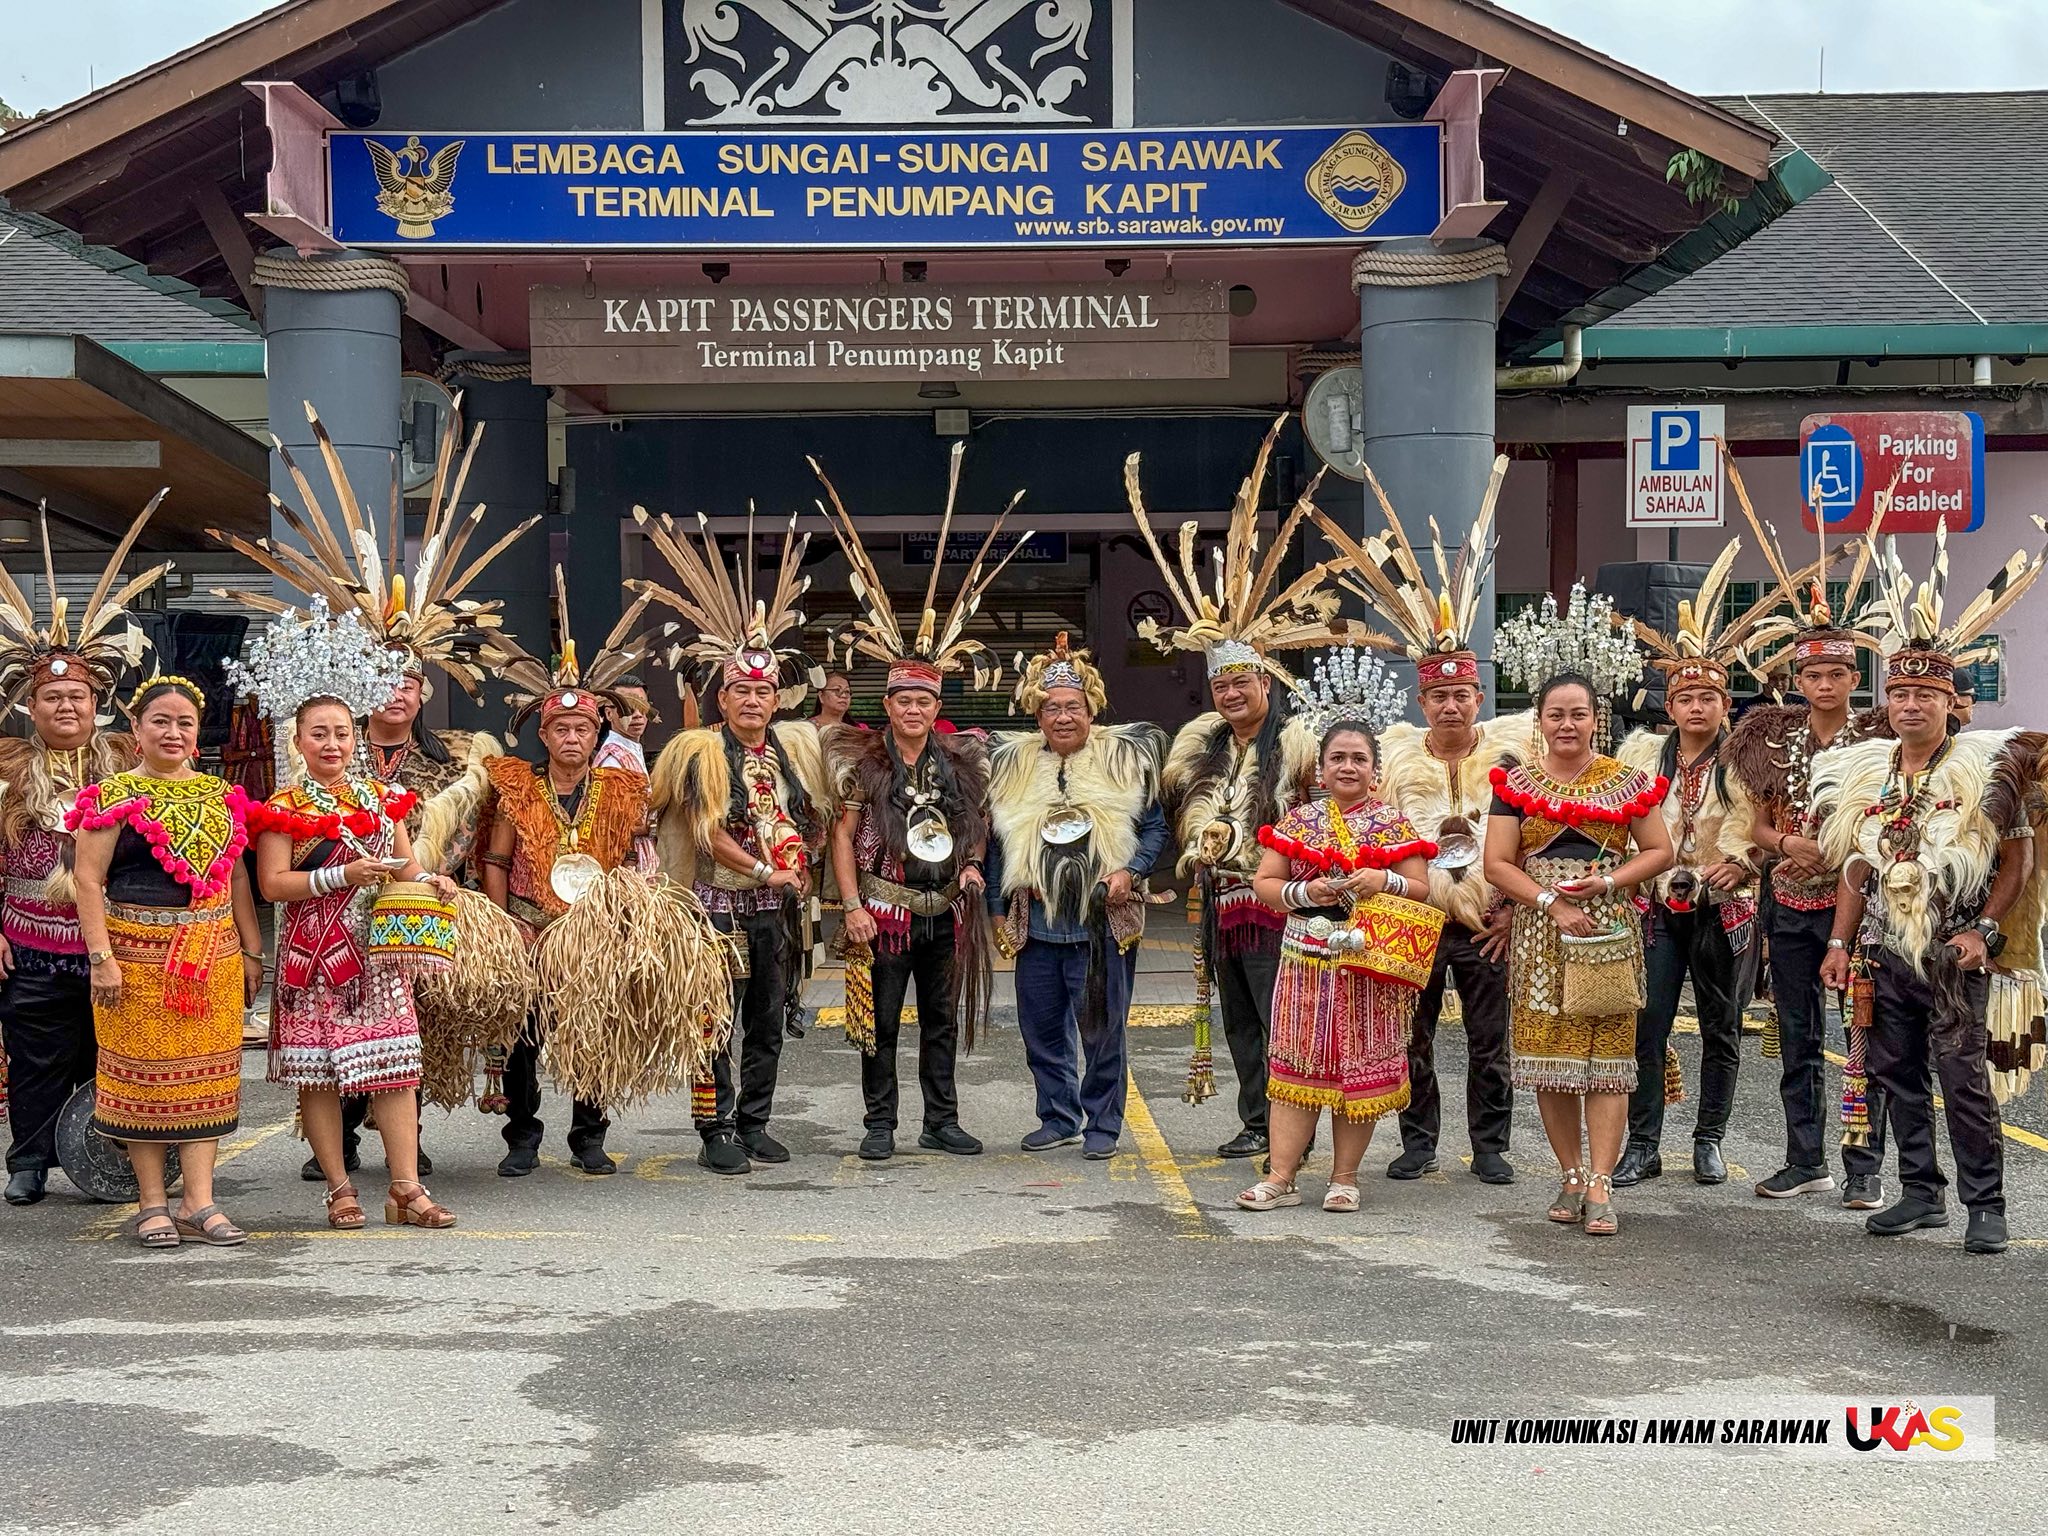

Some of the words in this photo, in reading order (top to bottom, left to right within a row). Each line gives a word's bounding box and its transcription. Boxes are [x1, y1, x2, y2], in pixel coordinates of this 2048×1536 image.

[487, 144, 683, 174] LEMBAGA
[719, 142, 1047, 173] SUNGAI-SUNGAI
[1082, 139, 1282, 171] SARAWAK
[1323, 154, 1342, 200] LEMBAGA
[569, 187, 773, 217] TERMINAL
[807, 185, 1054, 217] PENUMPANG
[1086, 182, 1207, 213] KAPIT
[1330, 200, 1380, 216] SARAWAK
[1015, 215, 1285, 237] www.srb.sarawak.gov.my
[603, 298, 716, 333] KAPIT
[729, 296, 953, 334] PASSENGERS
[967, 294, 1159, 331] TERMINAL
[696, 339, 817, 368] Terminal
[828, 340, 981, 373] Penumpang
[991, 338, 1065, 370] Kapit
[1660, 416, 1692, 465] P
[1879, 433, 1957, 461] Parking
[1639, 475, 1712, 493] AMBULAN
[1902, 461, 1935, 483] For
[1645, 495, 1706, 514] SAHAJA
